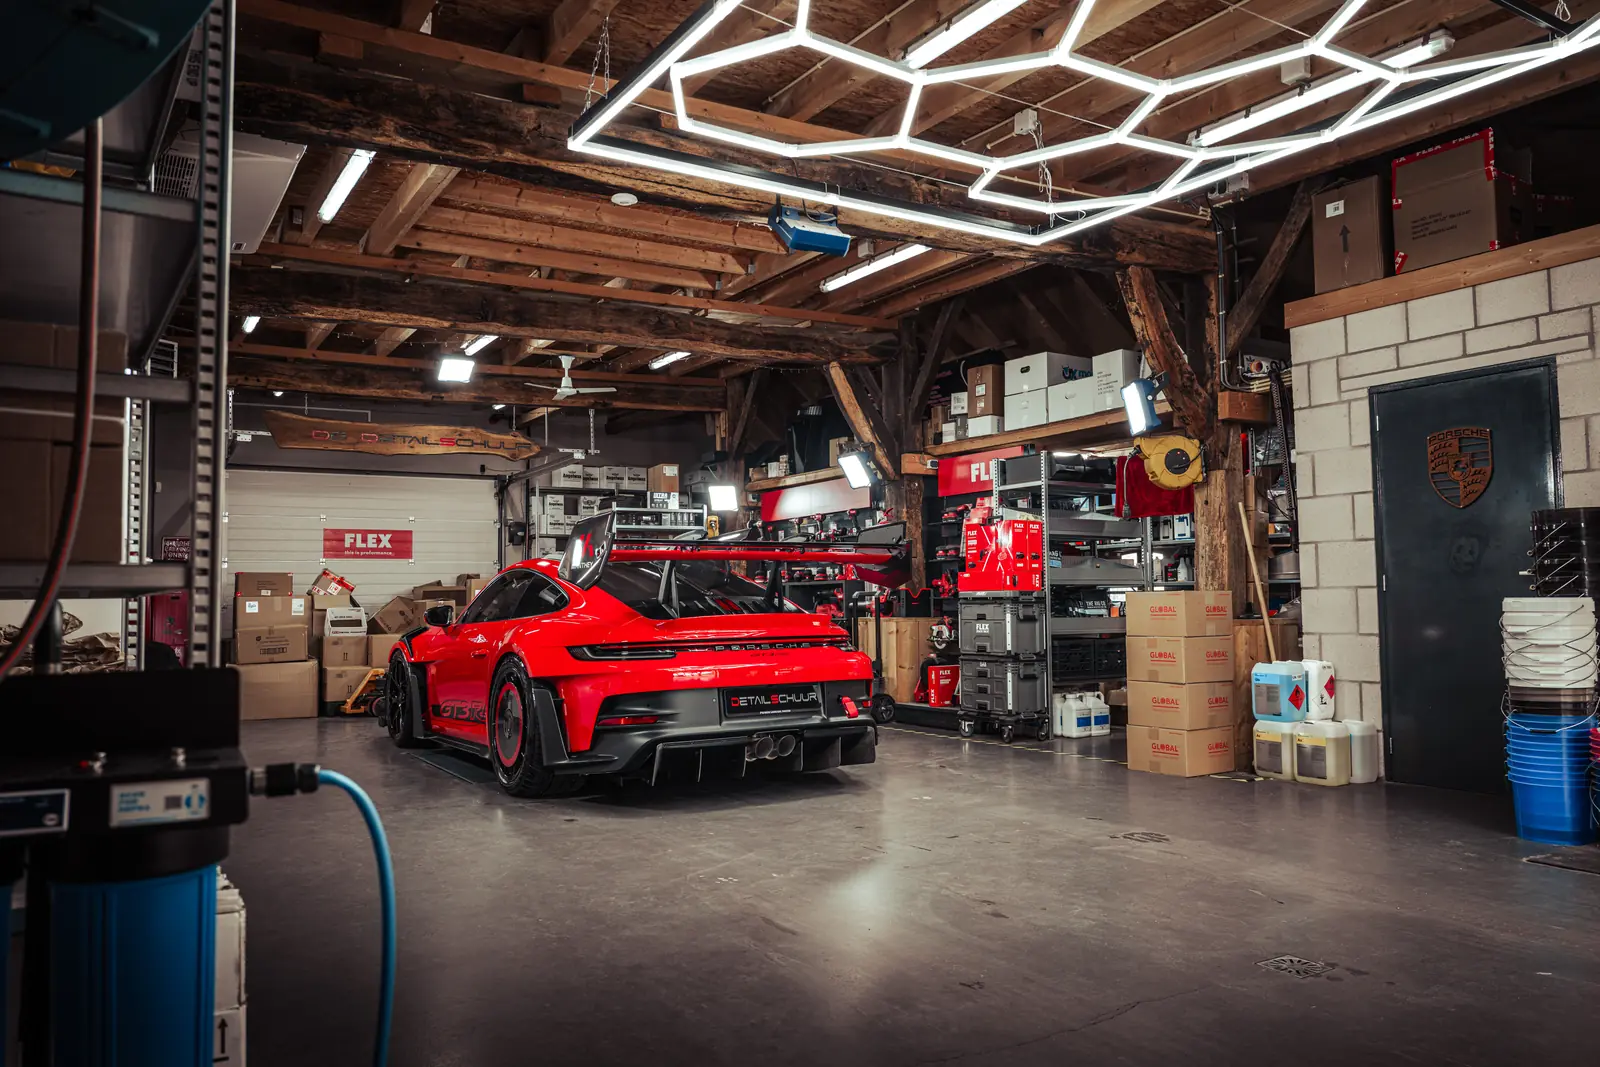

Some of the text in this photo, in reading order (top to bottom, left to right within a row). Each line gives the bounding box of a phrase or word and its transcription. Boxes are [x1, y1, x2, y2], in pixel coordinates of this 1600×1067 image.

[1429, 428, 1489, 444] PORSCHE
[344, 533, 392, 549] FLEX
[1206, 605, 1227, 613] GLOBAL
[715, 642, 811, 651] PORSCHE
[1150, 651, 1176, 659] GLOBAL
[1206, 650, 1228, 658] GLOBAL
[731, 692, 817, 707] DETAILSCHUUR
[1152, 696, 1179, 705] GLOBAL
[1207, 696, 1229, 705] GLOBAL
[1152, 742, 1178, 752] GLOBAL
[1207, 741, 1229, 750] GLOBAL
